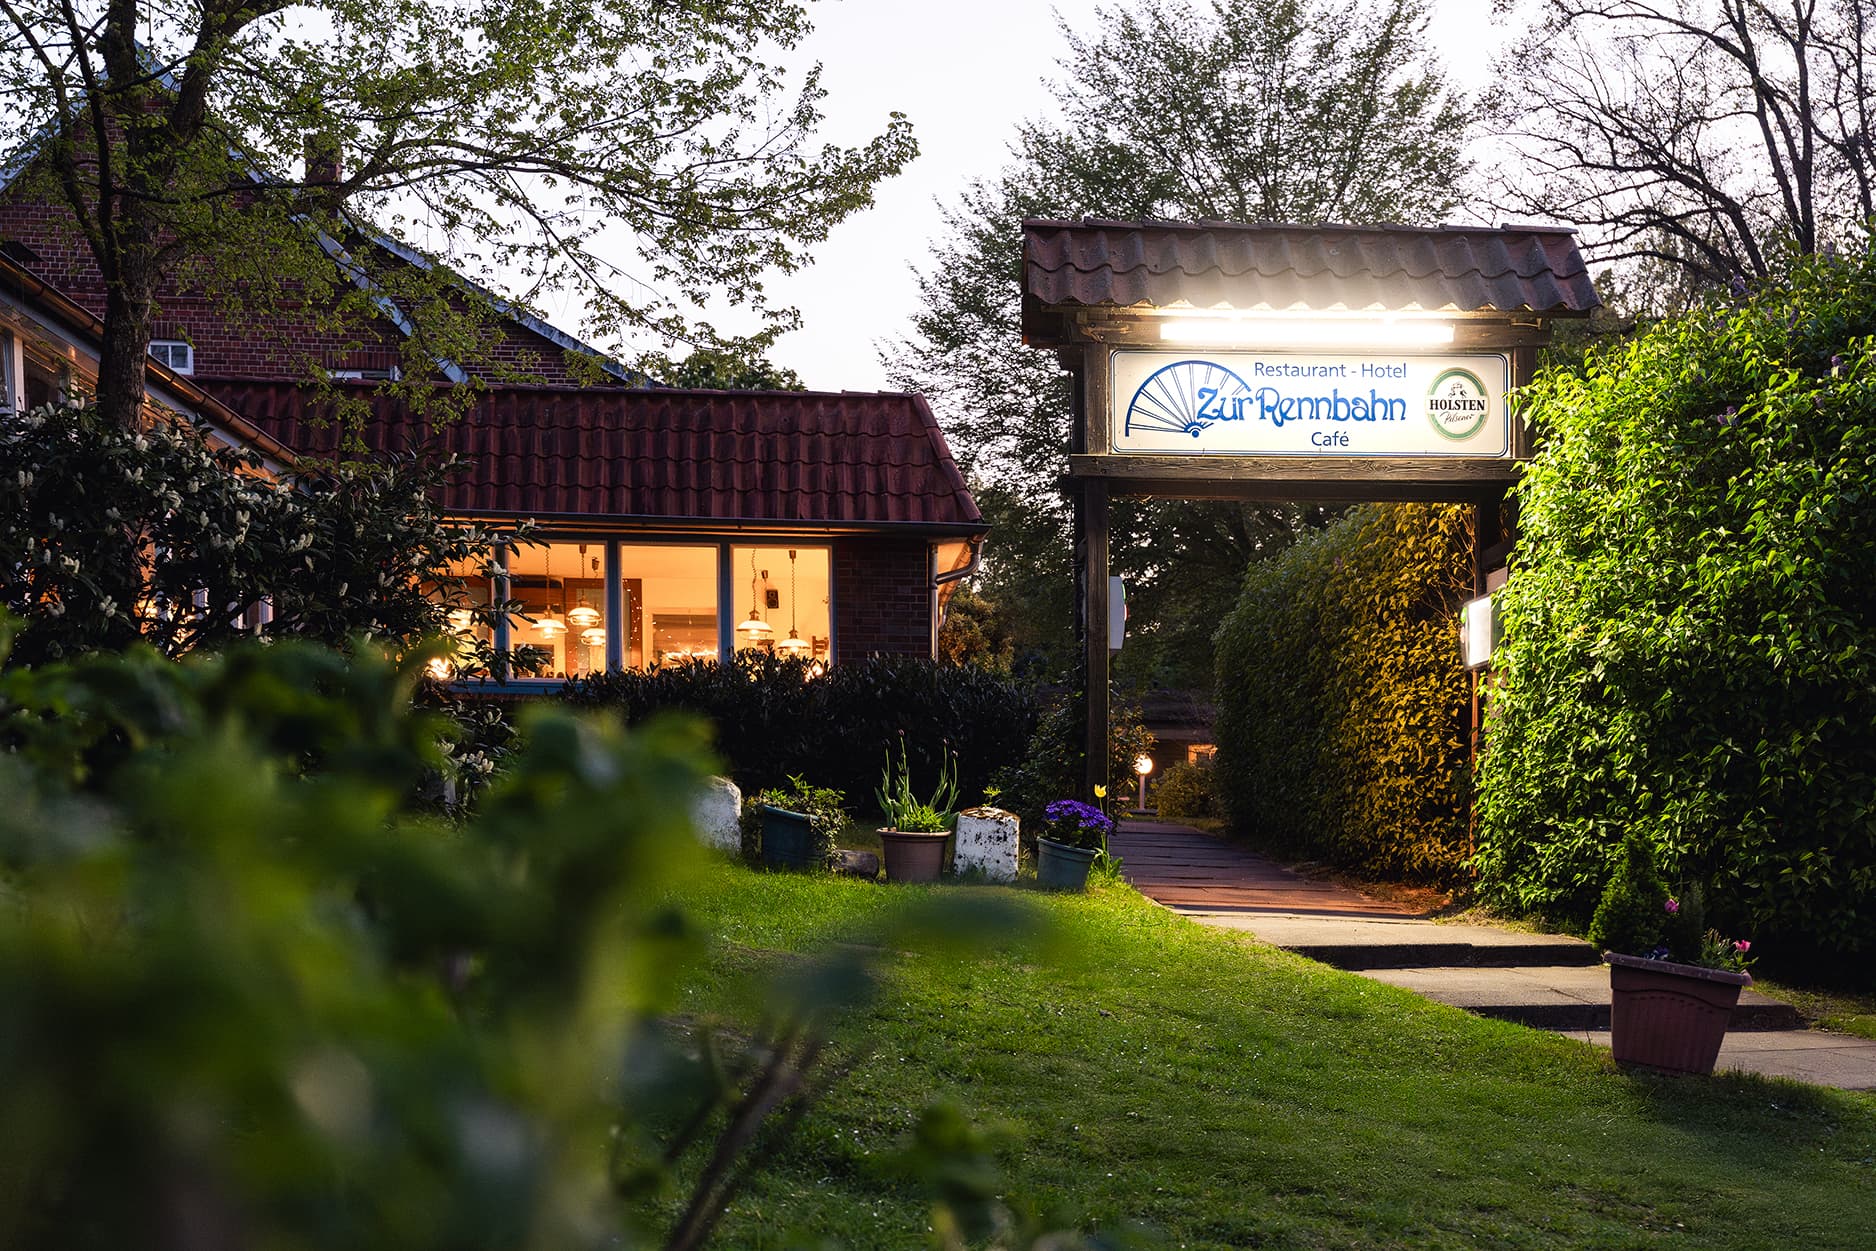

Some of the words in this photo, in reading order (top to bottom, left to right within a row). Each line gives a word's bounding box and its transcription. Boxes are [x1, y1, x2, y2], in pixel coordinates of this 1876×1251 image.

[1255, 362, 1346, 378] Restaurant
[1362, 362, 1407, 378] Hotel
[1197, 387, 1253, 421] Zur
[1255, 387, 1406, 427] Rennbahn
[1429, 399, 1485, 411] HOLSTEN
[1311, 431, 1349, 447] Café
